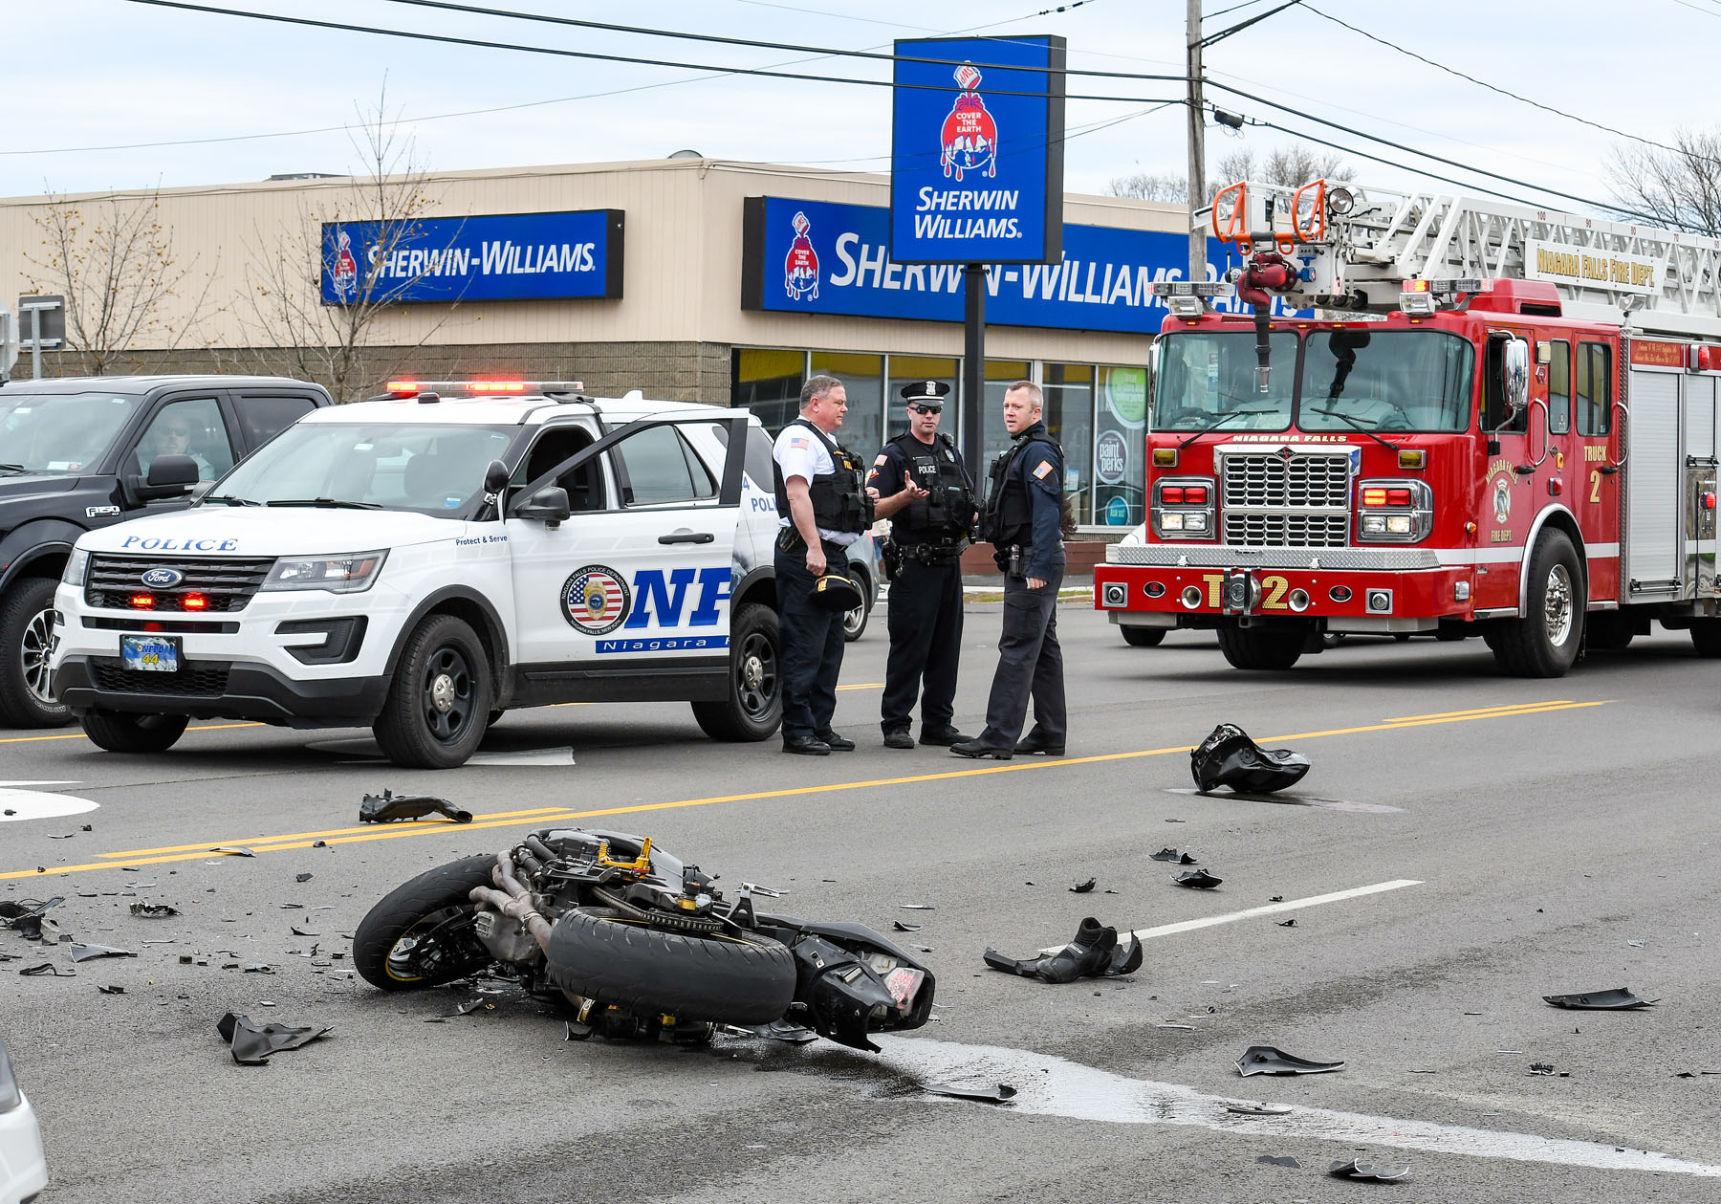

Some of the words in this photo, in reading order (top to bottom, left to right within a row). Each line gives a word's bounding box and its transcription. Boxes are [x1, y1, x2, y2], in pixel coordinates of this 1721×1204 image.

[956, 112, 982, 120] COVER
[956, 125, 982, 133] EARTH
[916, 186, 1019, 211] SHERWIN
[1536, 247, 1580, 278] NIAGARA
[1581, 254, 1609, 282] FALLS
[1609, 258, 1630, 285] FIRE
[1232, 435, 1300, 443] NIAGARA
[1303, 435, 1348, 443] FALLS
[1100, 441, 1120, 459] paint
[1583, 445, 1607, 462] TRUCK
[918, 465, 937, 474] POLICE
[1101, 457, 1124, 473] perks
[1589, 470, 1601, 503] 2
[121, 535, 239, 551] POLICE
[455, 537, 481, 546] Protect
[489, 535, 508, 543] Serve
[147, 571, 171, 583] Ford
[561, 578, 574, 600] NIAGARA
[572, 568, 587, 580] FALLS
[1261, 575, 1289, 610] 2
[603, 637, 708, 651] Niagara
[142, 652, 160, 666] 44
